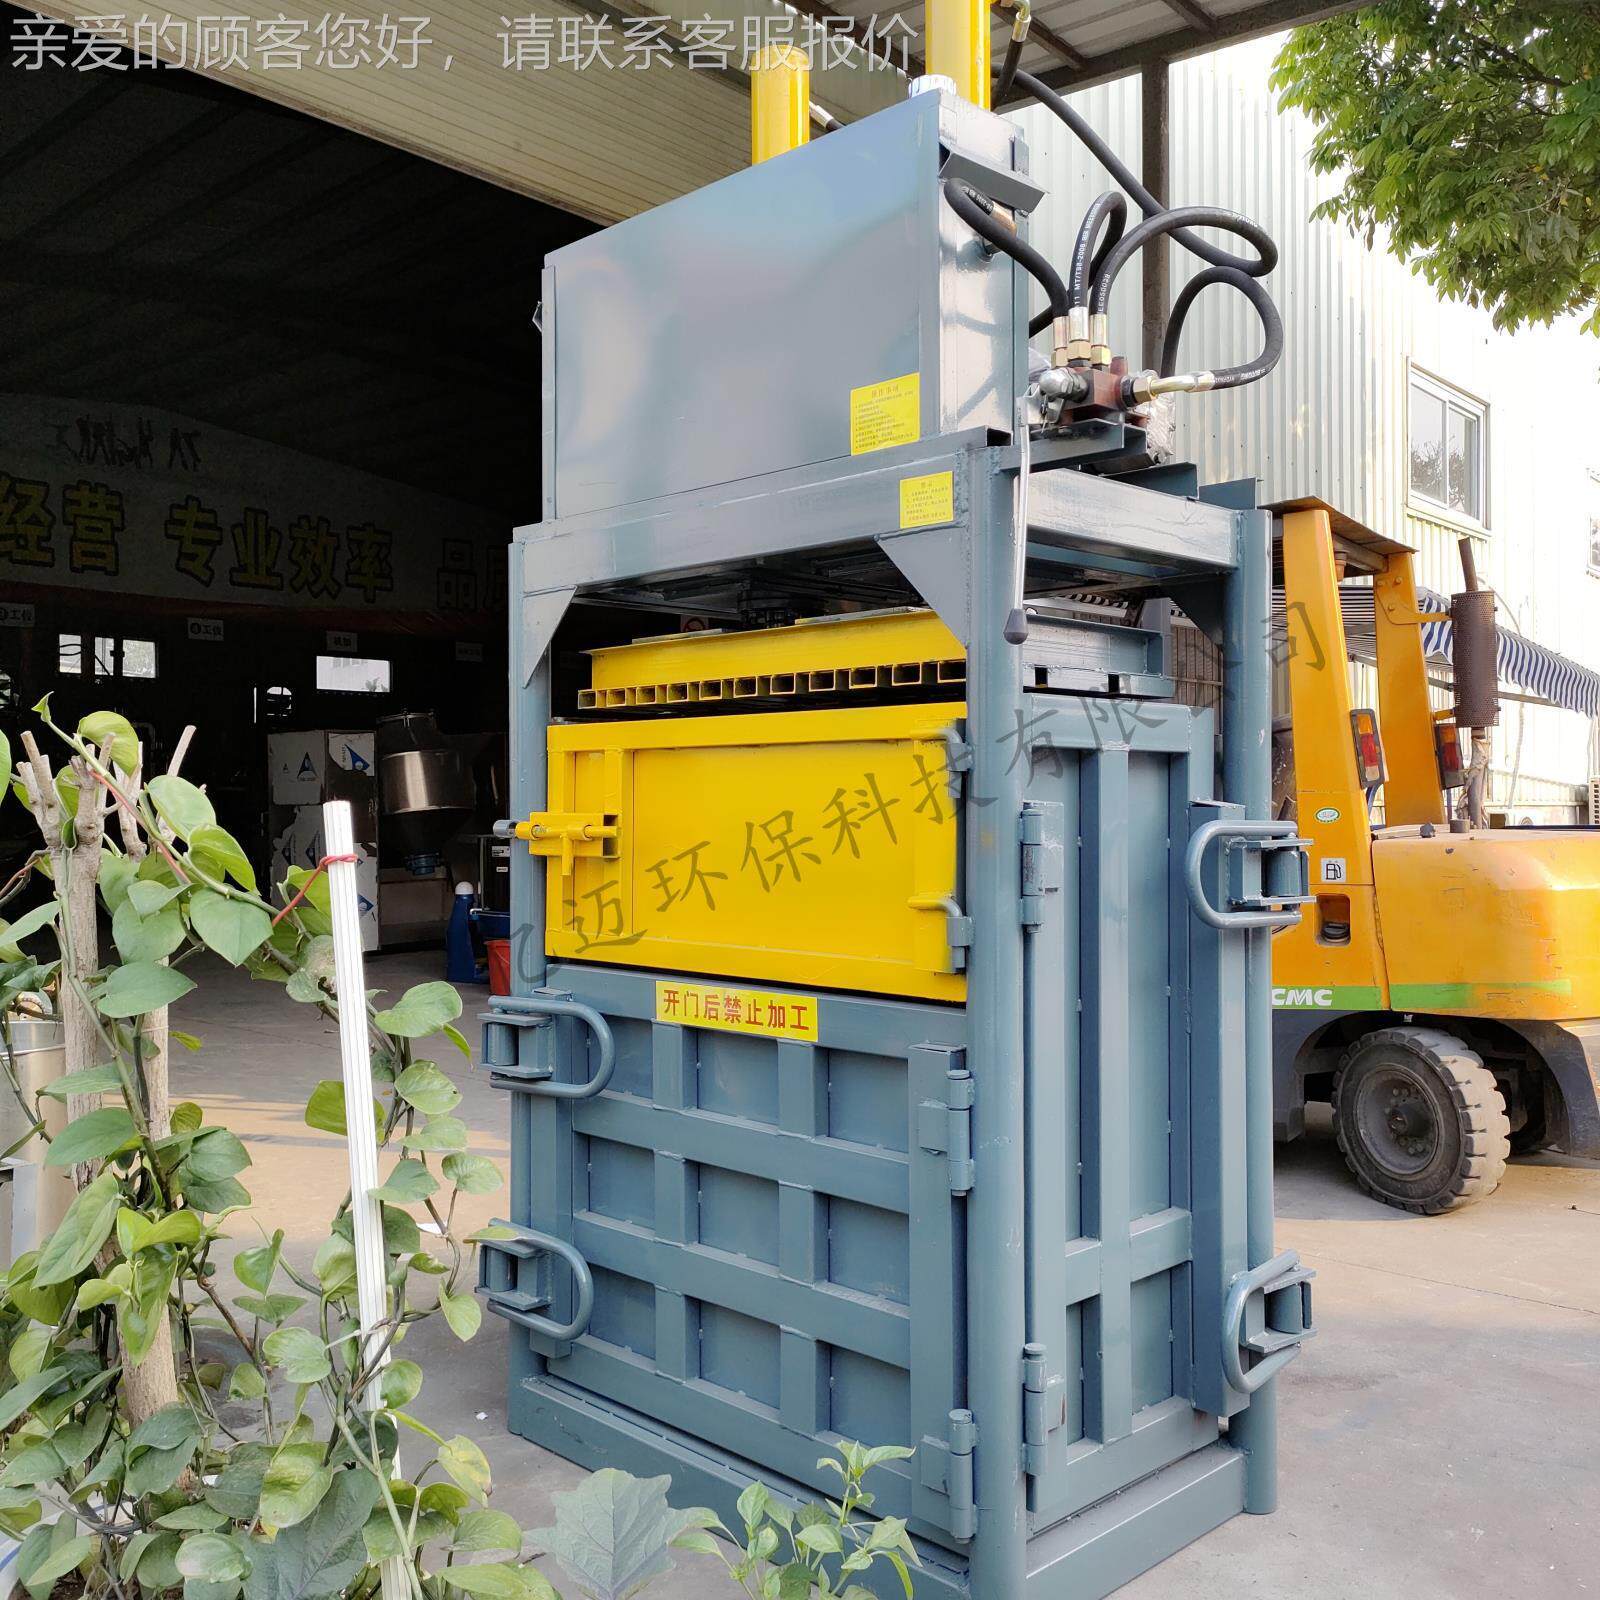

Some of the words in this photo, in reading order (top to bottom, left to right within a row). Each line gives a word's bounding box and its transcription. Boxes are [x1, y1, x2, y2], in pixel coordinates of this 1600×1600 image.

[164, 495, 394, 604] 专业效率
[663, 989, 810, 1031] 开门后禁止加工
